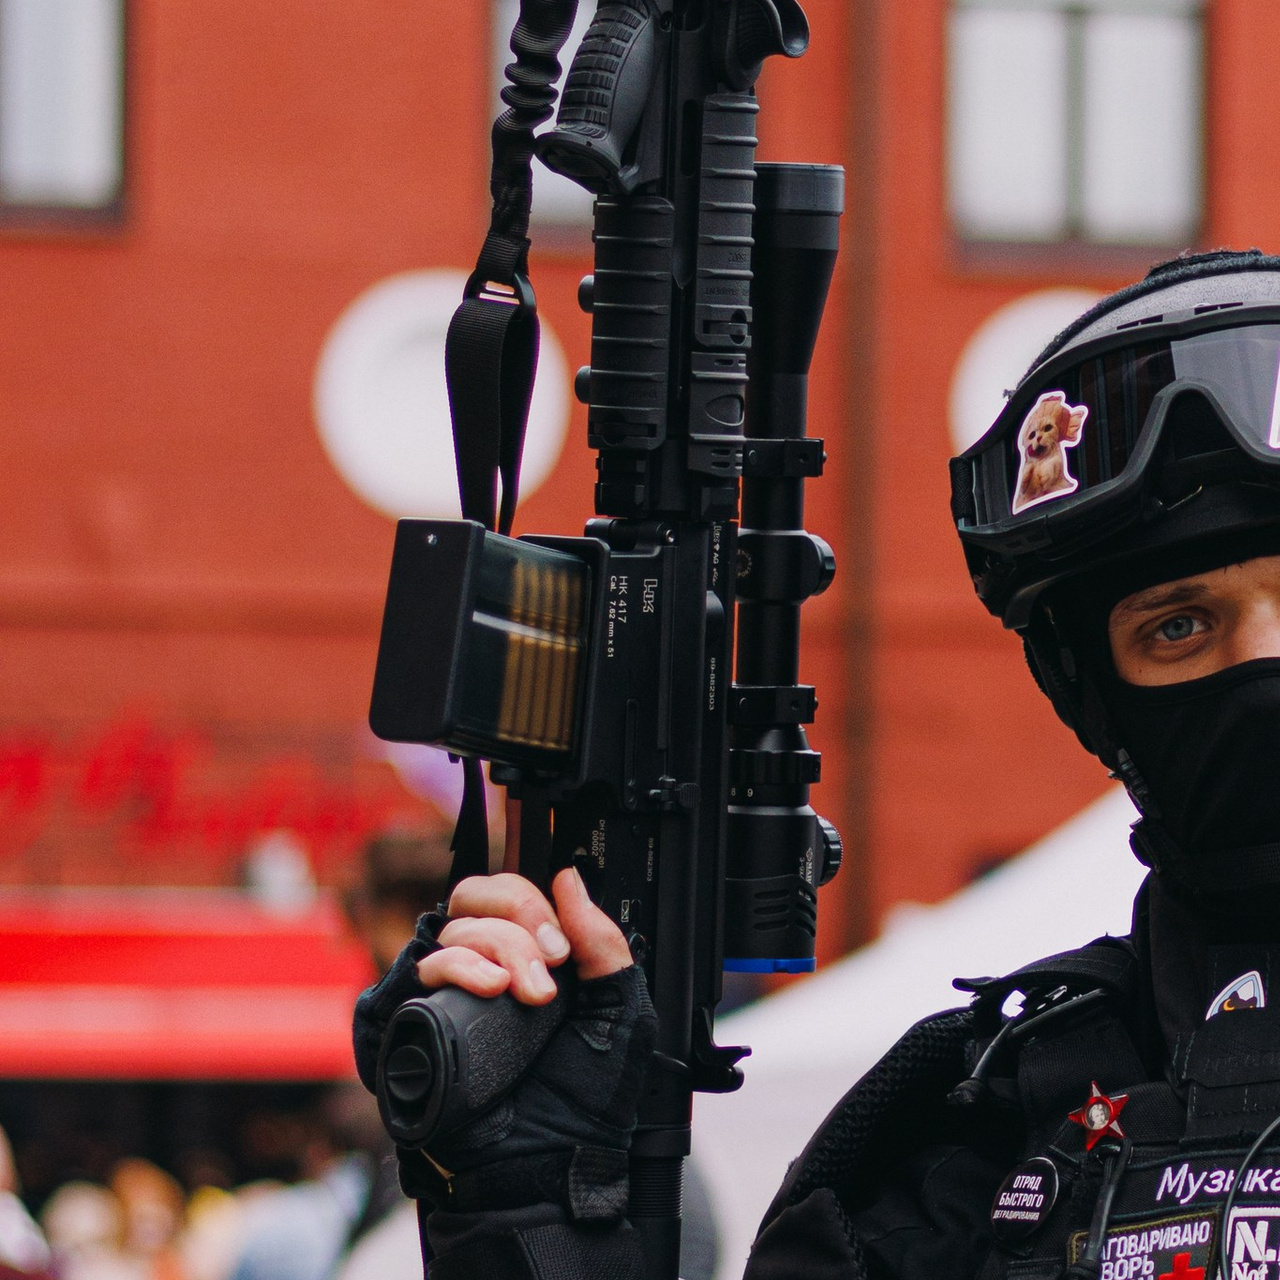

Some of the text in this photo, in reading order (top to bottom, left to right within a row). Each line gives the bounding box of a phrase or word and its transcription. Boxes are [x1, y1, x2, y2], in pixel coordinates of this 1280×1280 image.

[617, 575, 628, 624] HK 417
[608, 600, 616, 620] 7.62
[608, 621, 614, 638] mm
[607, 647, 614, 659] 51
[747, 788, 754, 798] 9
[591, 829, 599, 857] 00002
[1012, 1175, 1043, 1191] ОТРЯД
[998, 1192, 1044, 1208] БЫСТРОГО
